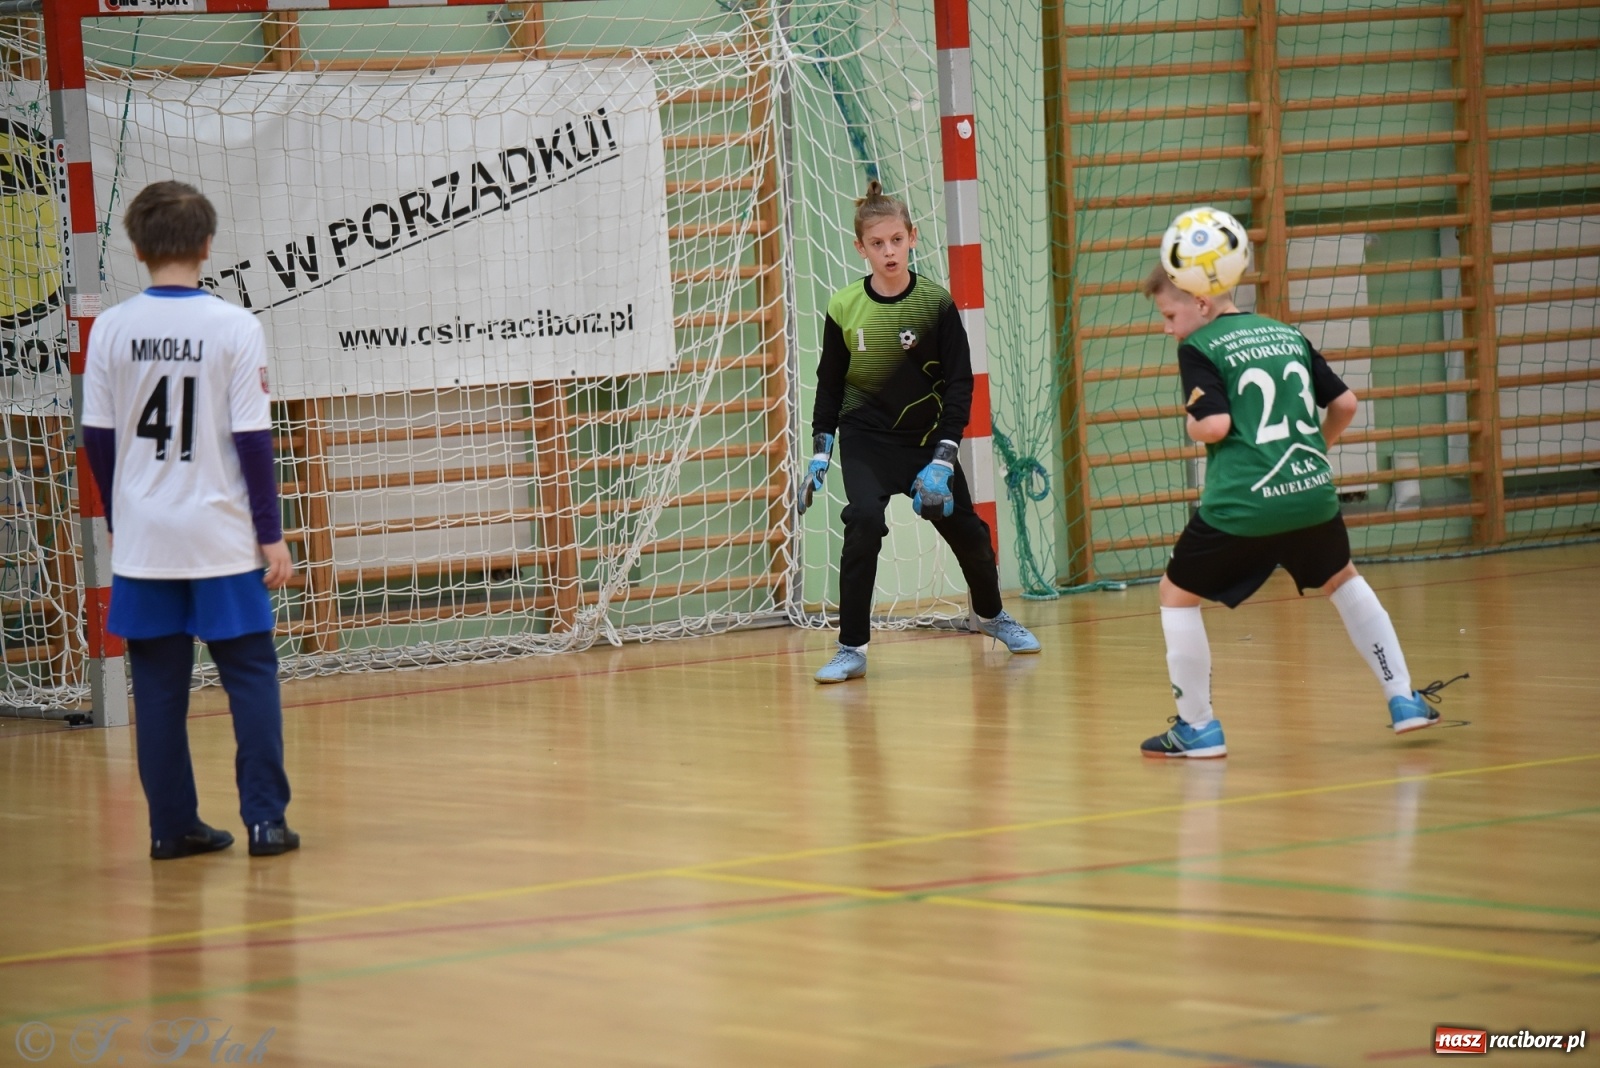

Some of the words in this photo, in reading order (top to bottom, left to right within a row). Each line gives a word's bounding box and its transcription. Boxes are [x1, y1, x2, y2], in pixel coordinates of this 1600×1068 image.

[267, 233, 320, 292] W
[131, 338, 204, 362] MIKOŁAJ
[856, 328, 867, 351] 1
[1208, 328, 1254, 350] AKADEMIA
[1225, 340, 1304, 368] TWORKÓW
[1238, 361, 1319, 444] 23
[137, 375, 197, 462] 41
